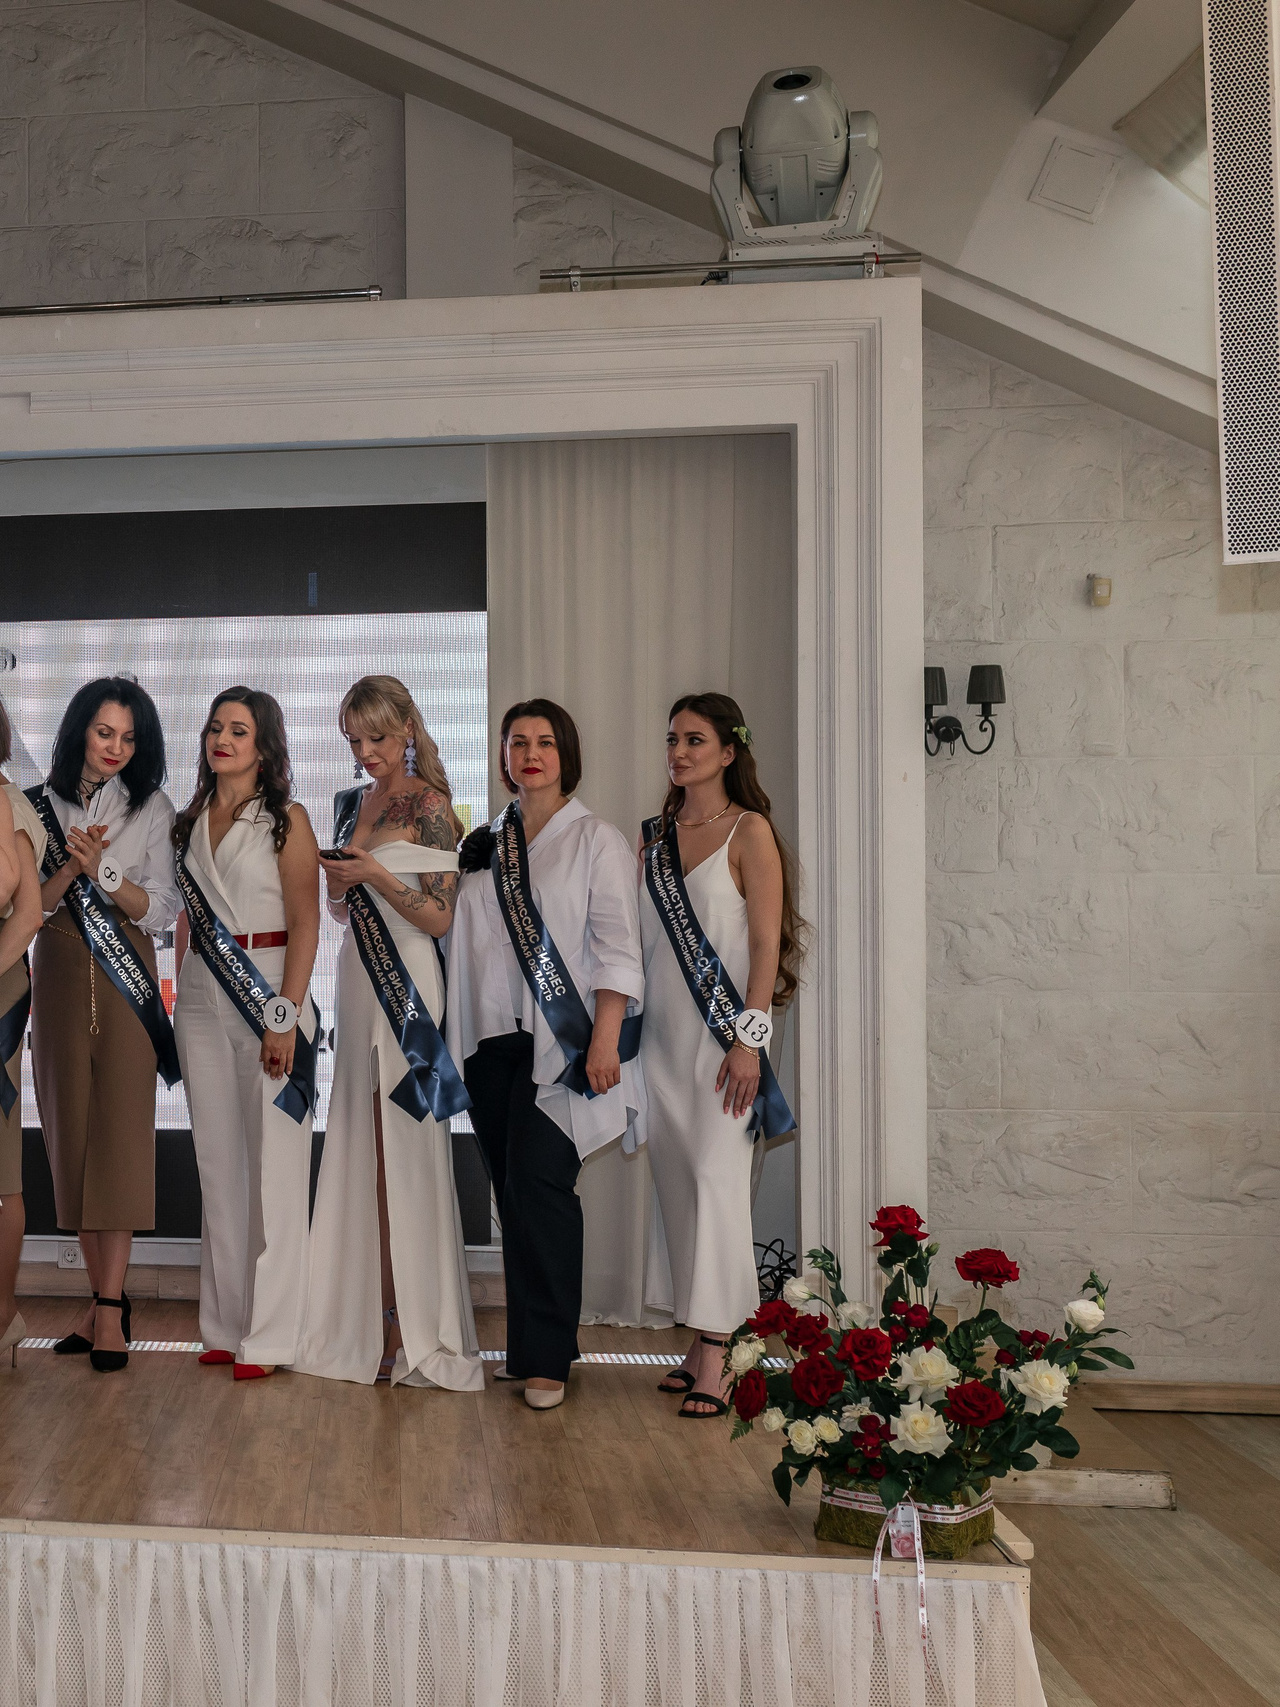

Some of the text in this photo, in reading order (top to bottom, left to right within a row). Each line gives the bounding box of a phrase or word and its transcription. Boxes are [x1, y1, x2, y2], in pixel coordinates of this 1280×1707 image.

[104, 866, 117, 882] 8
[176, 861, 217, 941] ФИНАЛИСТКА
[214, 937, 254, 988] МИССИС
[506, 822, 566, 996] ФИНАЛИСТКА МИССИС БИЗНЕС
[660, 844, 689, 929] ФИНАЛИСТКА
[684, 928, 718, 984] МИССИС
[70, 901, 121, 970] НОВОСИБИРСКАЯ
[117, 968, 144, 1006] ОБЛАСТЬ
[87, 904, 125, 955] МИССИС
[121, 954, 153, 999] БИЗНЕС
[199, 933, 250, 1004] НОВОСИБИРСКАЯ
[351, 909, 388, 985] НОВОСИБИРСКАЯ
[382, 984, 406, 1026] ОБЛАСТЬ
[367, 916, 419, 1021] МИССИС БИЗНЕС
[502, 881, 532, 959] НОВОСИБИРСКАЯ
[528, 958, 553, 1002] ОБЛАСТЬ
[651, 849, 734, 1041] НОВОСИБИРСК И НОВОСИБИРСКАЯ ОБЛАСТЬ
[275, 1005, 287, 1024] 9
[740, 1013, 769, 1042] 13
